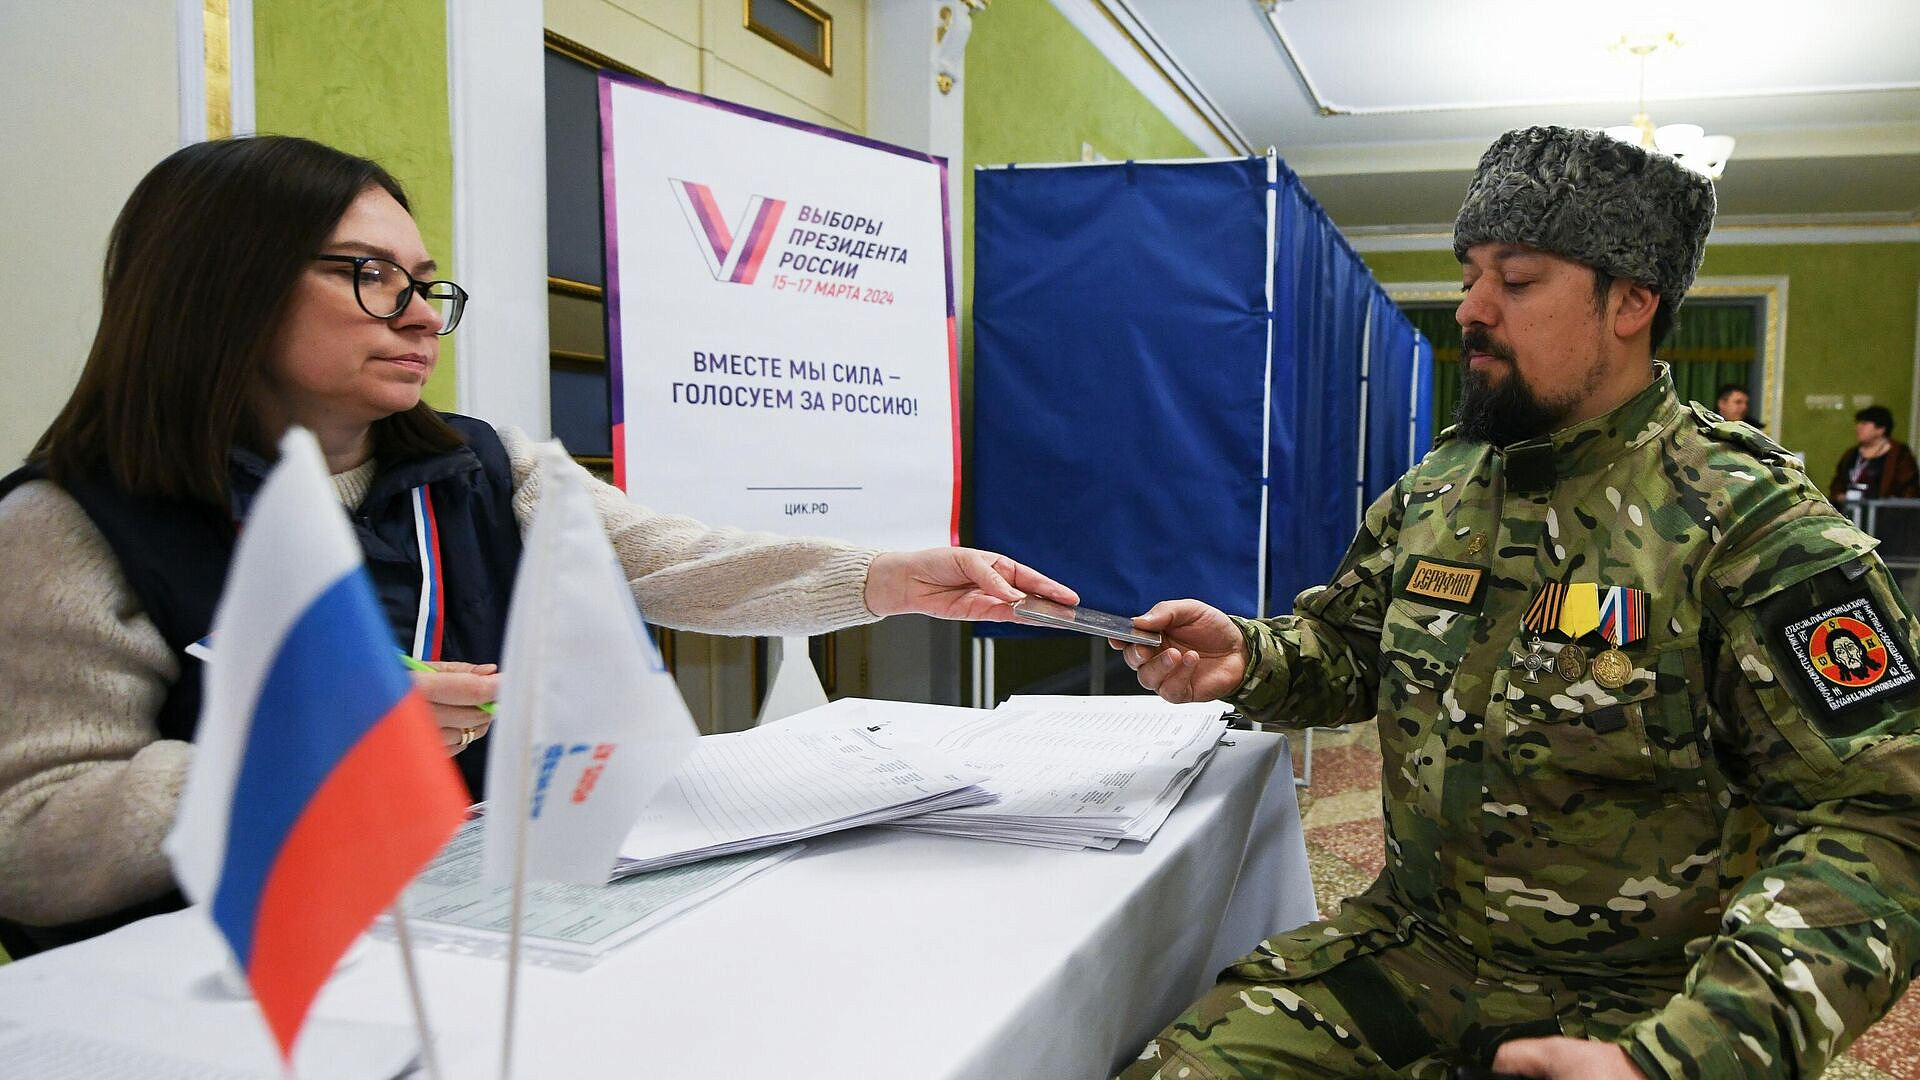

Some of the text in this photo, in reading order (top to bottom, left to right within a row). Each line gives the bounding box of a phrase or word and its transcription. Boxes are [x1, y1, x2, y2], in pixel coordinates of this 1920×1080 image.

[798, 205, 883, 236] ВЫБОРЫ
[788, 228, 908, 264] ПРЕЗИДЕНТА
[778, 251, 859, 279] РОССИИ
[814, 281, 860, 301] МАРТА
[863, 288, 896, 305] 2024
[693, 351, 782, 378] ВМЕСТЕ
[790, 359, 826, 381] МЫ
[833, 363, 883, 386] СИЛА
[672, 382, 918, 416] ГОЛОСУЕМ ЗА РОССИЮ!
[784, 502, 829, 515] ЦИК.РФ
